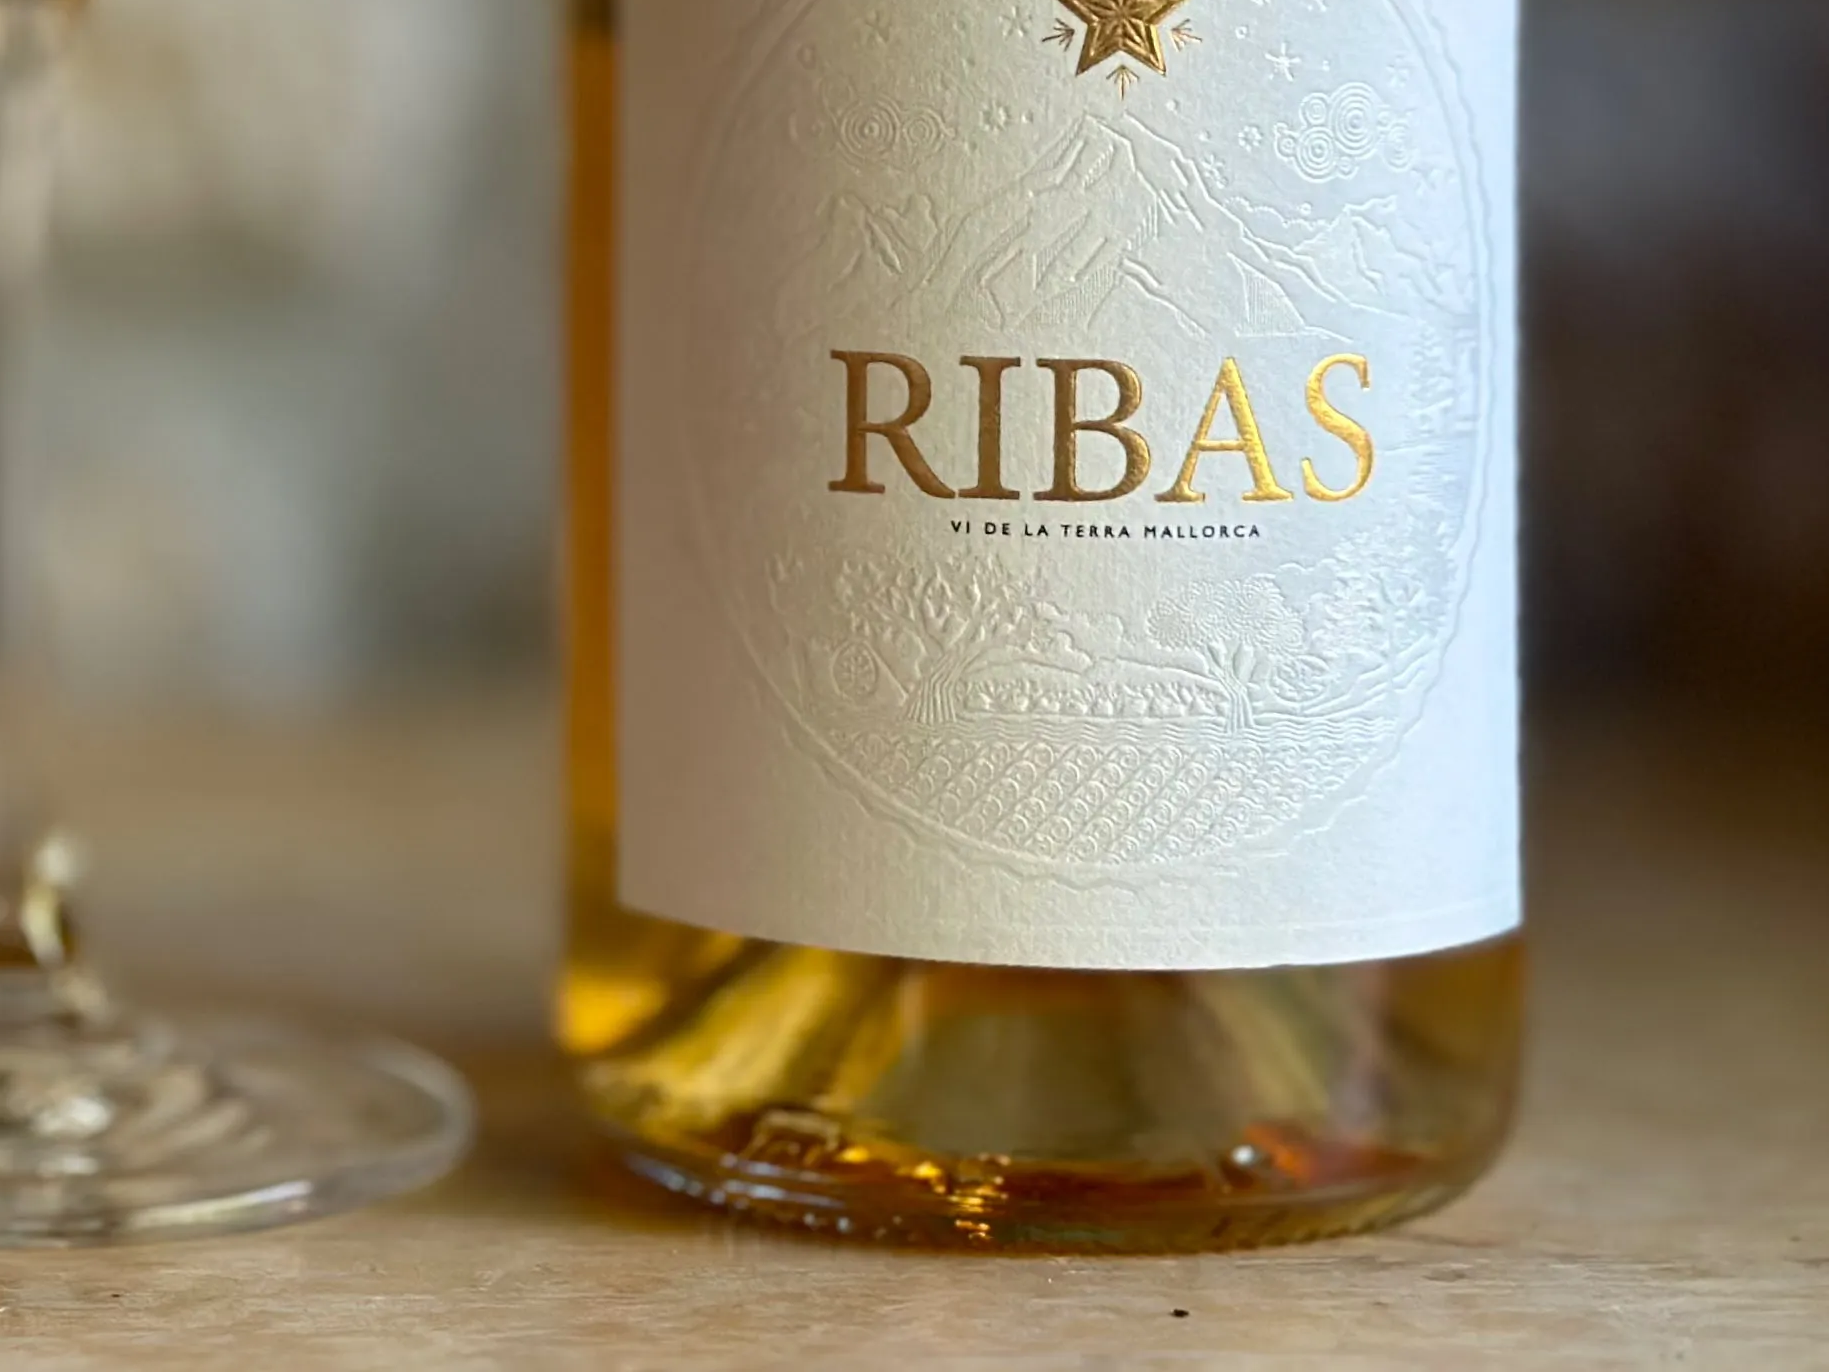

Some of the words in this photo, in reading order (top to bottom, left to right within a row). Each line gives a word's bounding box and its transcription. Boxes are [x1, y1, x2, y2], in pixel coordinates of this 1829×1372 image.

[827, 349, 1376, 504] RIBAS
[949, 519, 971, 534] VI
[983, 521, 1012, 536] DE
[1023, 523, 1050, 537] LA
[1059, 523, 1131, 538] TERRA
[1142, 524, 1261, 539] MALLORCA
